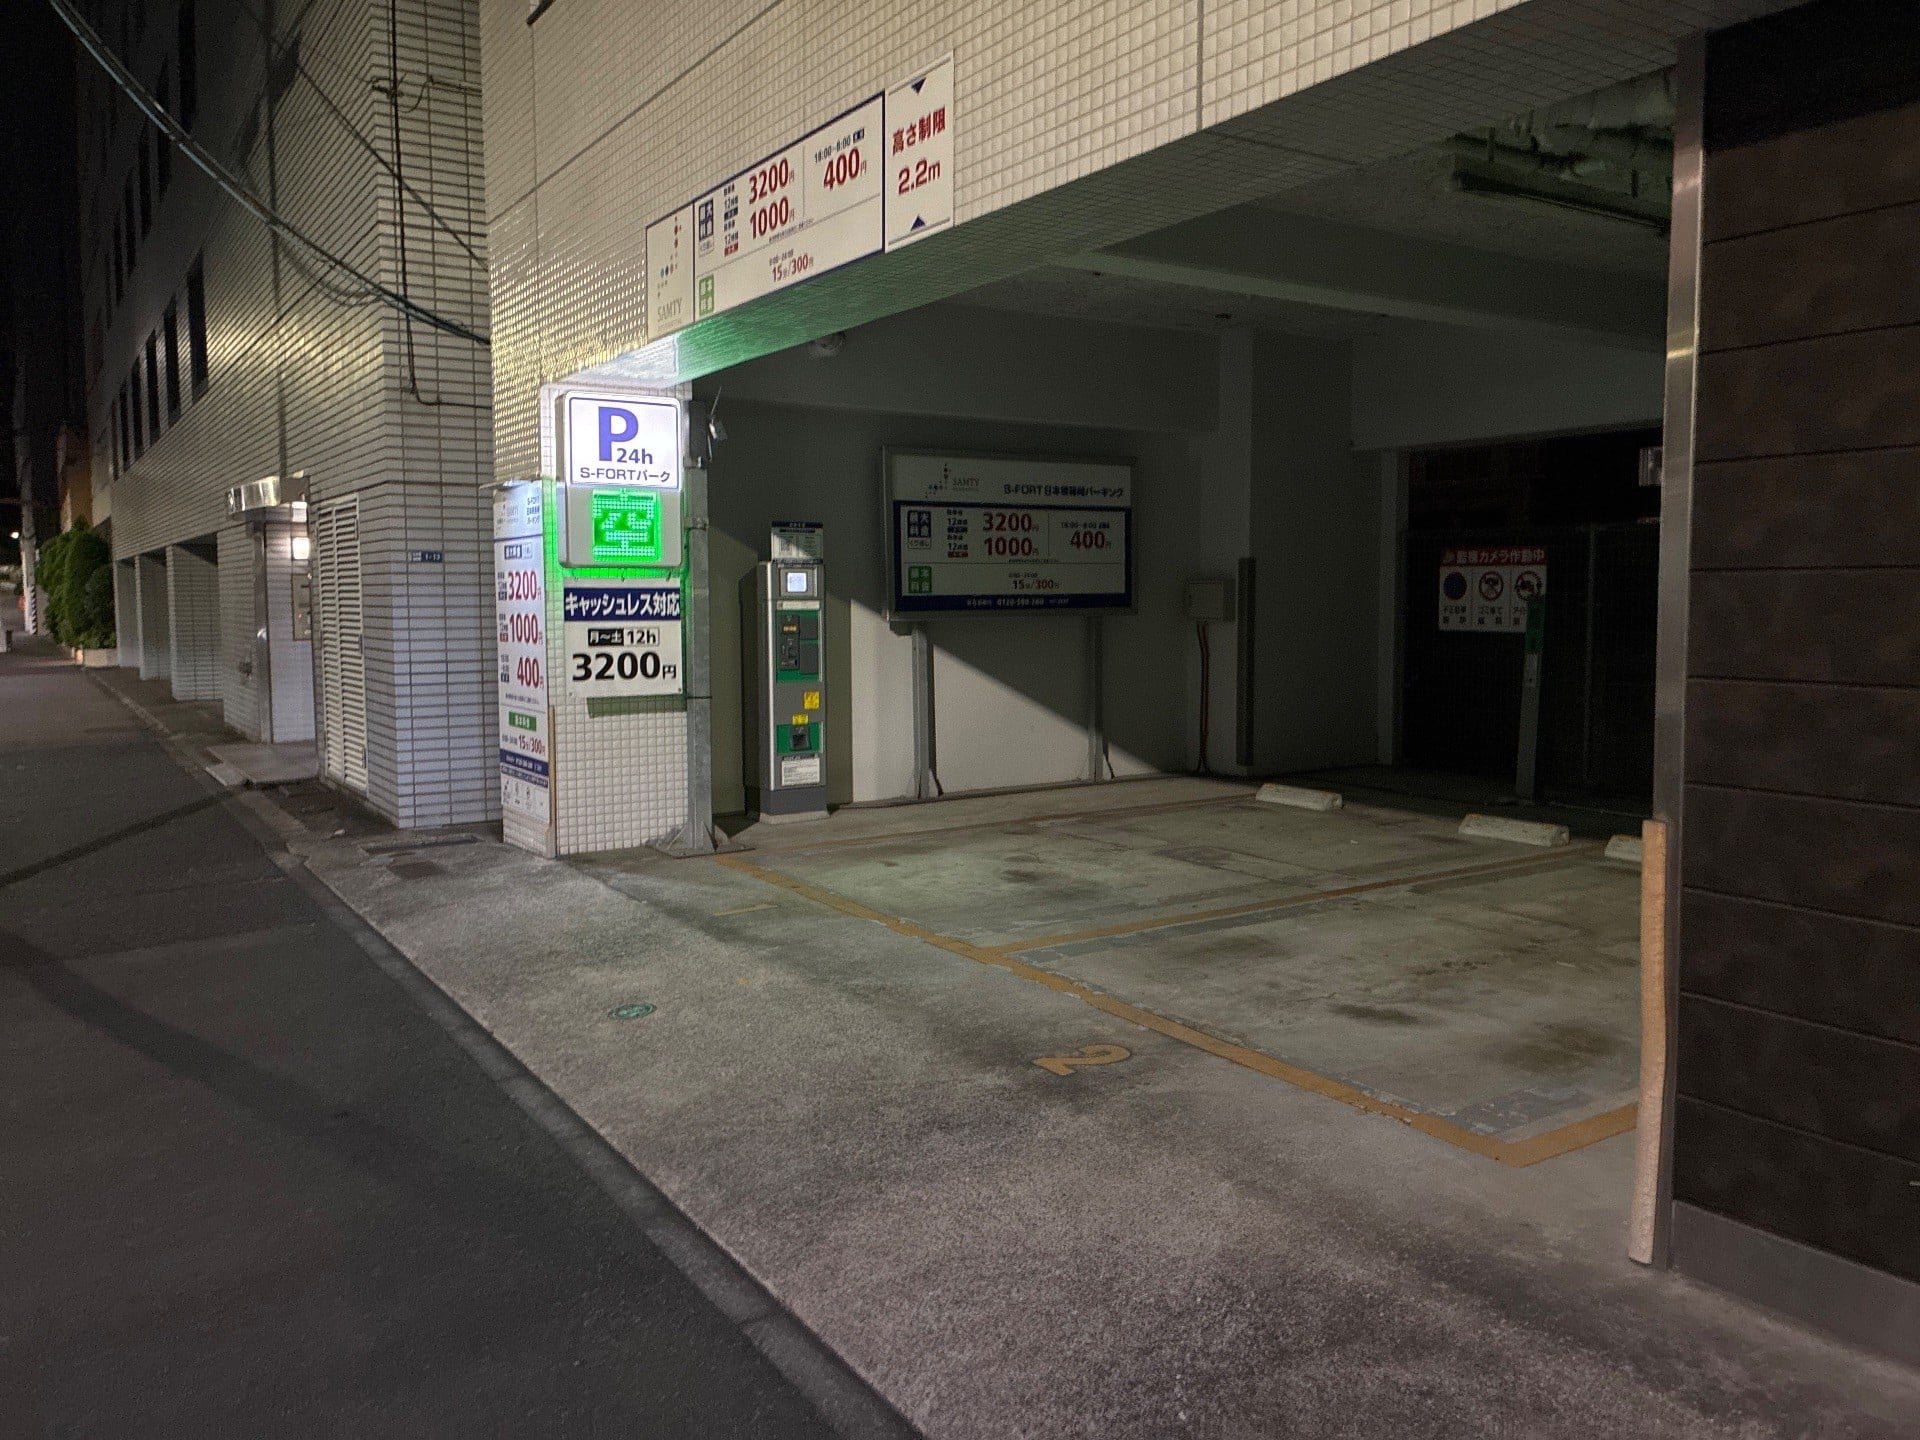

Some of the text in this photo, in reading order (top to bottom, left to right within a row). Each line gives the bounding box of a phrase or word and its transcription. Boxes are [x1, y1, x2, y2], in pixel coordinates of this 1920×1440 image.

[892, 106, 946, 156] 高さ制限
[898, 157, 941, 196] 2.2m
[657, 299, 683, 323] SAMTY
[598, 406, 639, 462] P
[616, 448, 653, 465] 24h
[580, 467, 670, 482] S-FORTパーク
[592, 488, 656, 557] 空
[565, 592, 680, 617] キャッシュレス対応
[627, 630, 656, 644] 12h
[572, 652, 677, 681] 3200円
